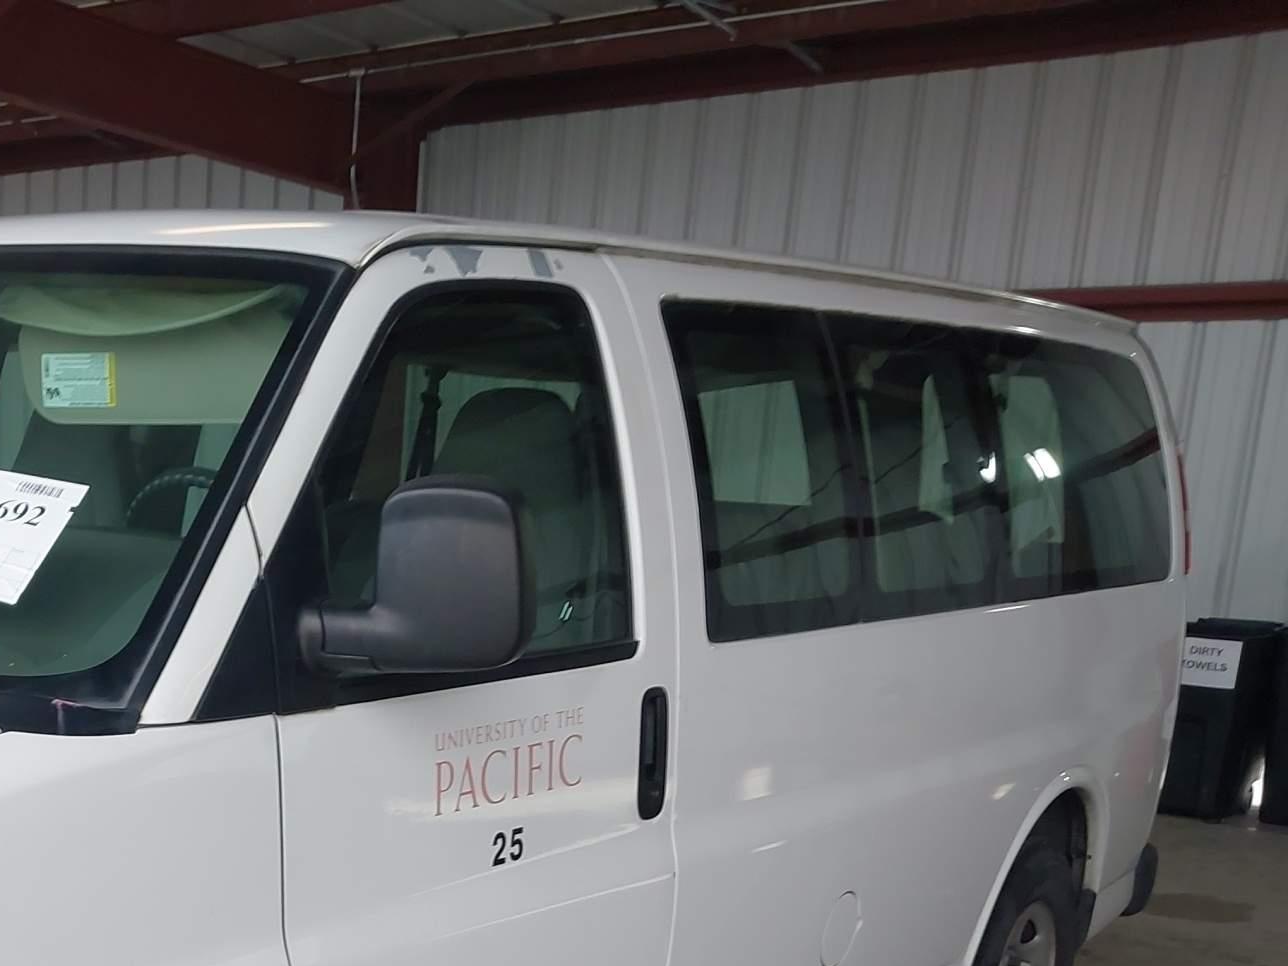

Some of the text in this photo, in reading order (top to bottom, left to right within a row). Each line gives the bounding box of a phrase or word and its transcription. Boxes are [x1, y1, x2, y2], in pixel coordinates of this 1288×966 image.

[1190, 645, 1224, 656] DIRTY
[434, 706, 584, 751] UNIVERSITY OF THE
[434, 734, 583, 816] PACIFIC
[492, 827, 524, 866] 25
